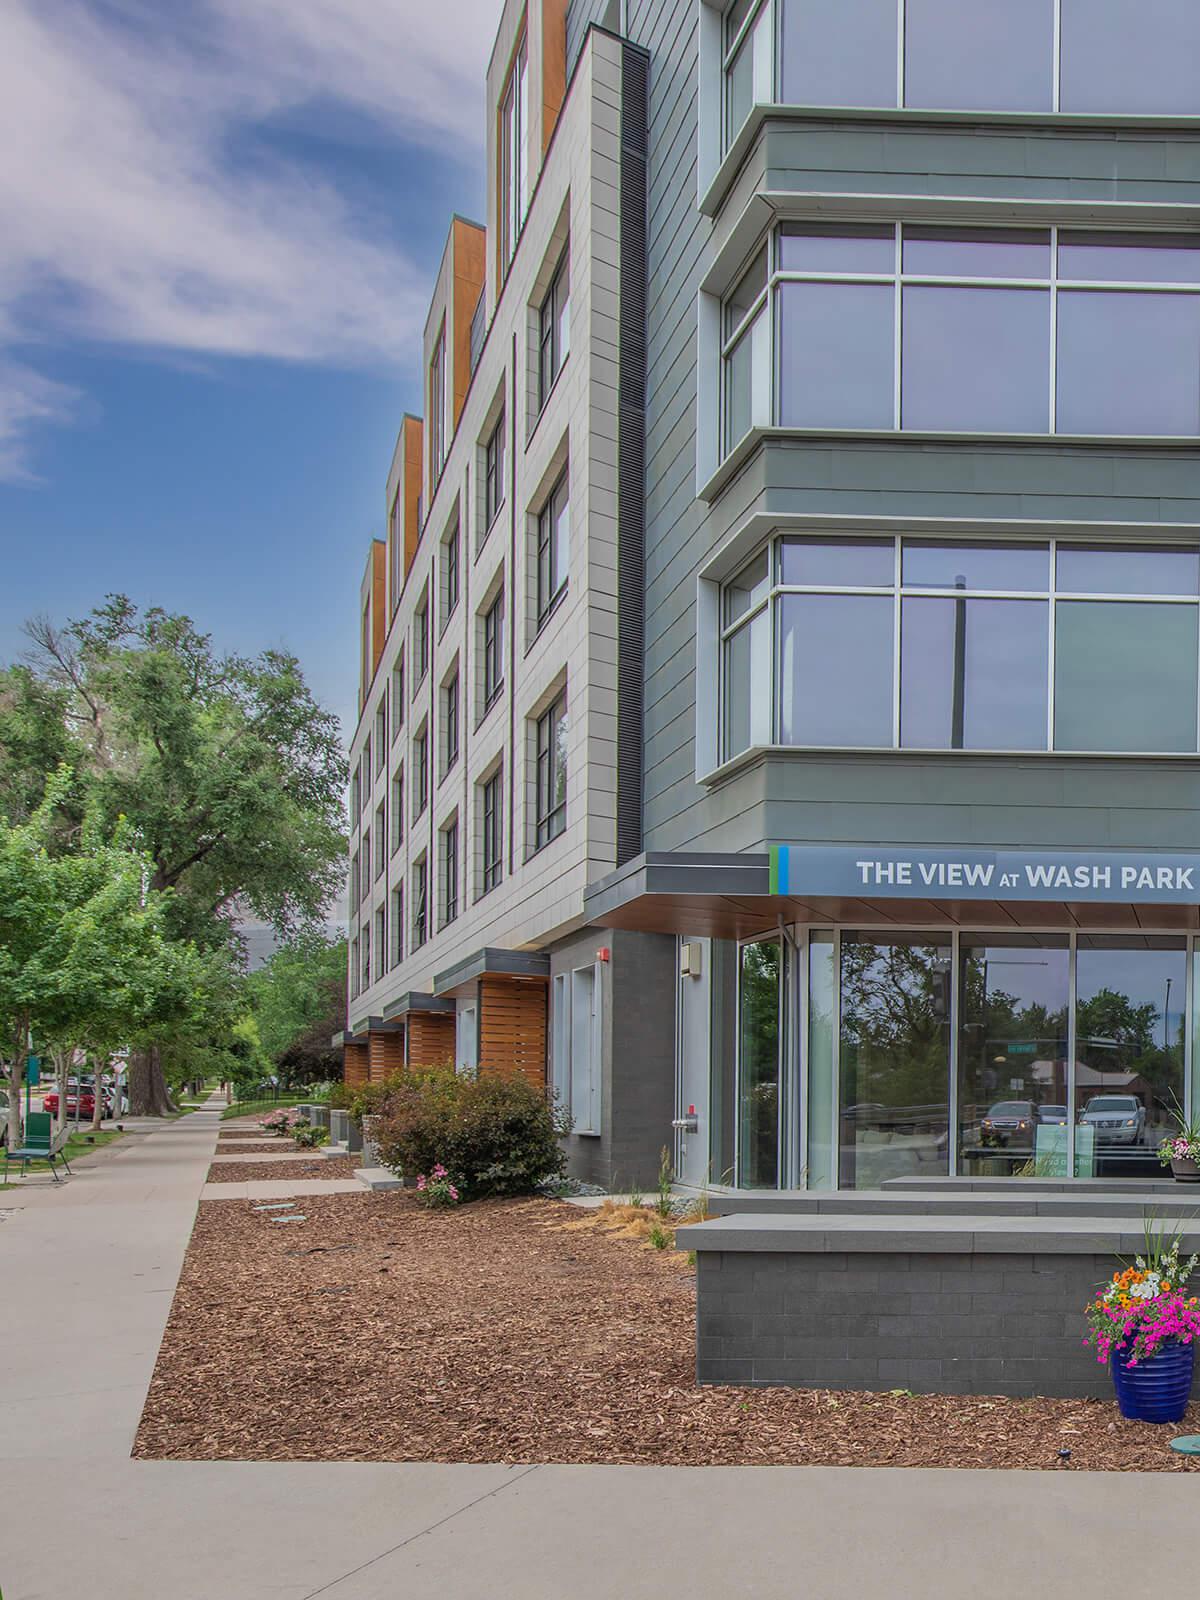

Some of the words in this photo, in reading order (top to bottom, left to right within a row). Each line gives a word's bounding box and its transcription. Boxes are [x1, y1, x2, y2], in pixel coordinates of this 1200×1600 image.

[856, 861, 912, 885] THE
[918, 863, 995, 887] VIEW
[999, 873, 1020, 888] AT
[1025, 865, 1111, 889] WASH
[1120, 866, 1194, 890] PARK
